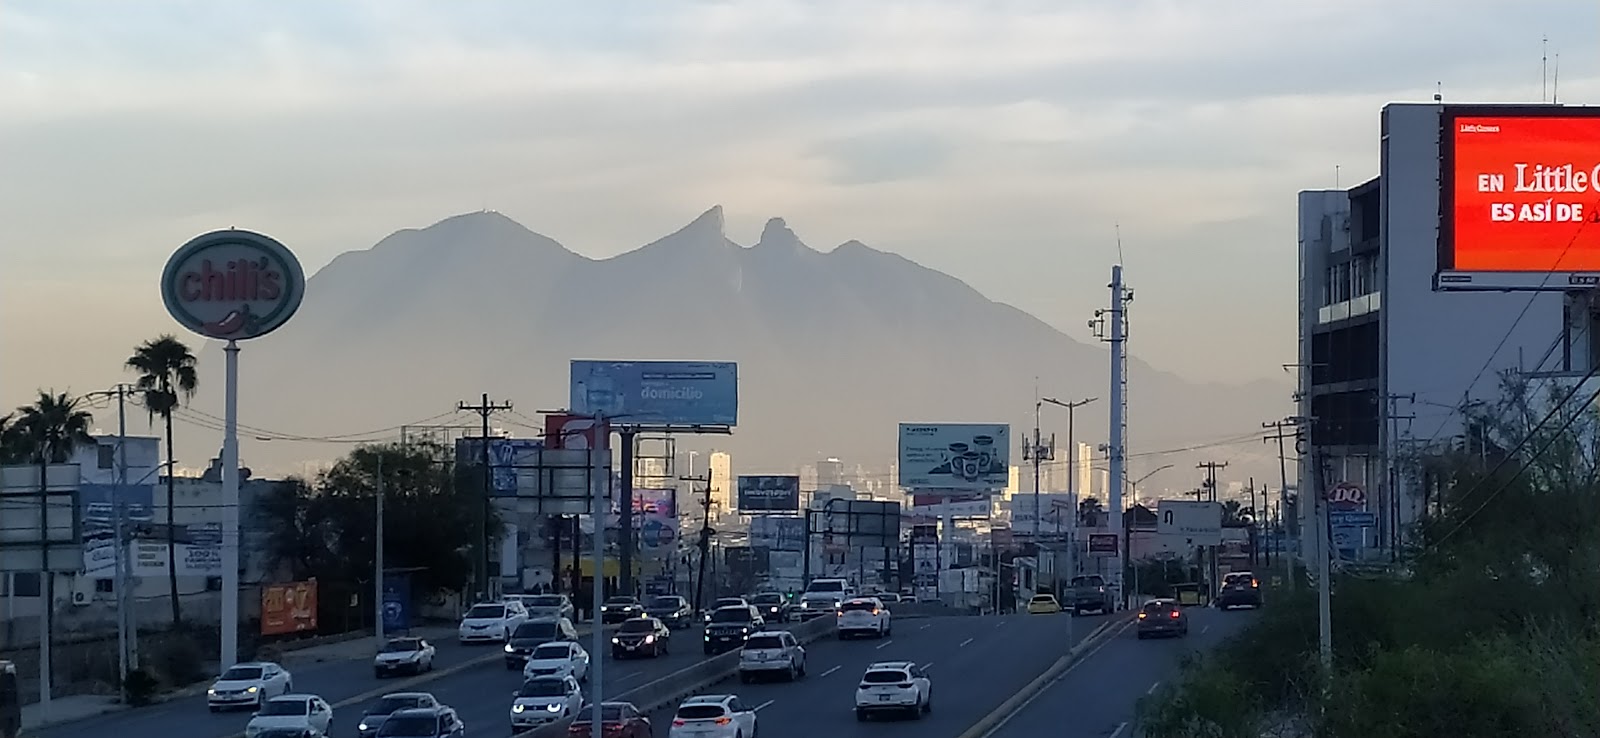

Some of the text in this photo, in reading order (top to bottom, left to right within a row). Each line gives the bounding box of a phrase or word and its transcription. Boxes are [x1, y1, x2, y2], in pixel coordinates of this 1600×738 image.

[1478, 174, 1505, 192] EN
[1514, 163, 1588, 193] Little
[1491, 203, 1515, 222] ES
[1518, 197, 1553, 222] ASÍ
[1556, 203, 1583, 222] DE
[180, 256, 281, 302] chili's
[640, 386, 703, 400] domicilio
[1334, 488, 1361, 503] DQ
